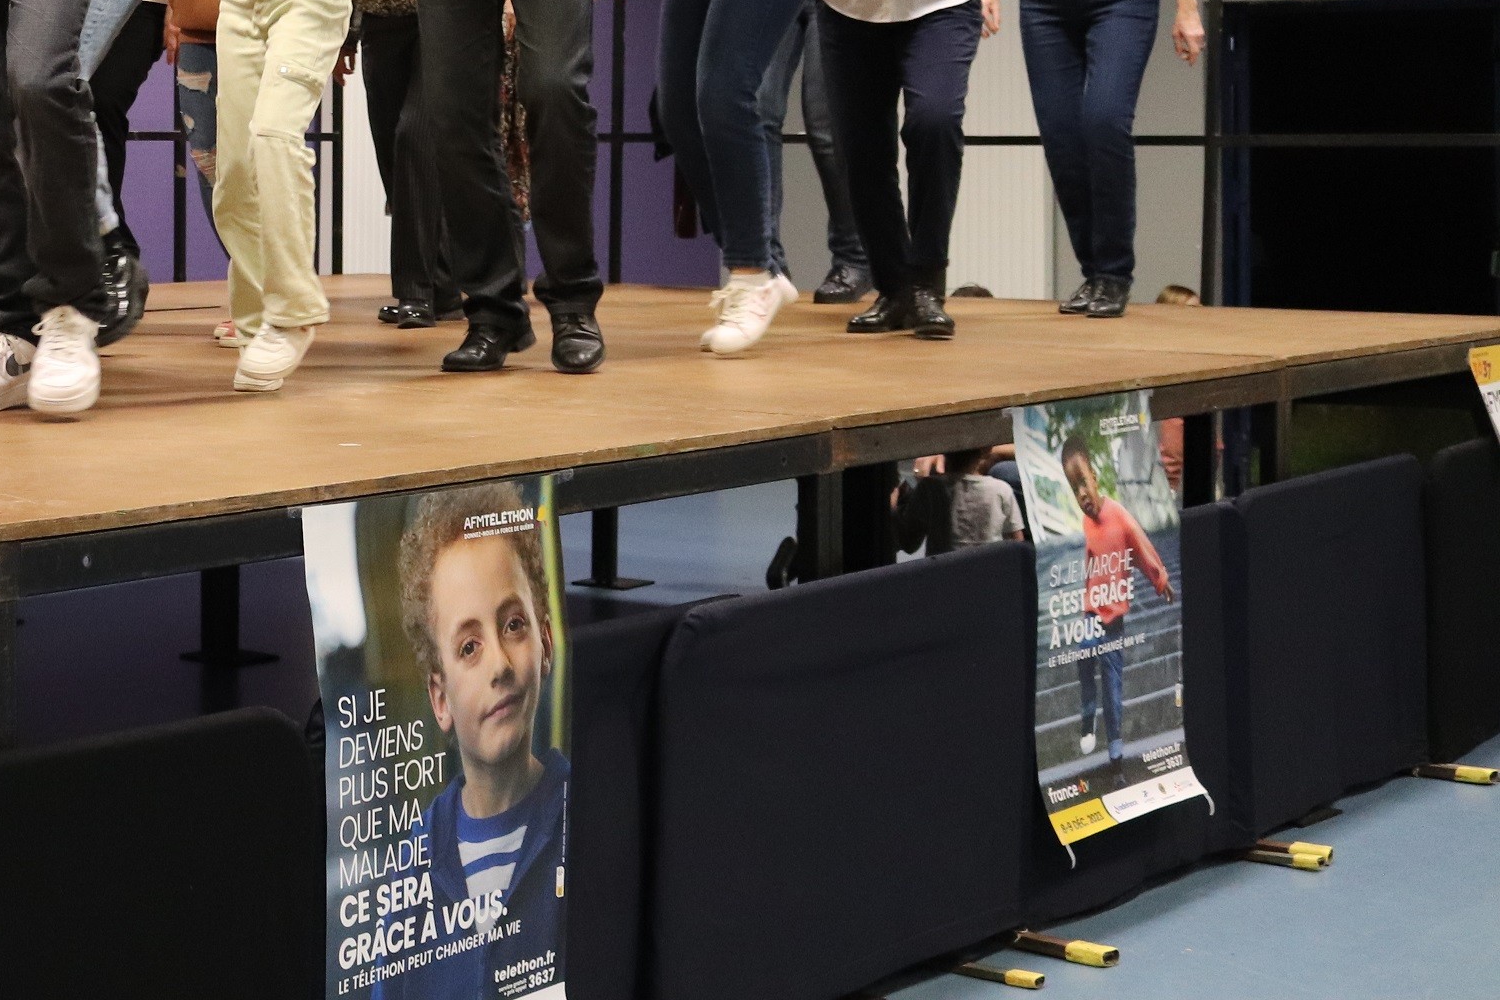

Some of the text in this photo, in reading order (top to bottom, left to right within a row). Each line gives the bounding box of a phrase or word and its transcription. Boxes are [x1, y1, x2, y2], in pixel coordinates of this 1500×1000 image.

[464, 530, 495, 540] DONNEZ-NOUS
[1050, 548, 1135, 588] SI JE MARCHE
[1049, 575, 1134, 618] C'EST GRÂCE
[1049, 632, 1145, 668] LE TÉLÉTHON A CHANGÉ MA VIE
[1050, 615, 1105, 650] À VOUS.
[338, 689, 387, 729] SI JE
[339, 720, 424, 769] DEVIENS
[1142, 742, 1180, 763] telethon.fr
[1165, 754, 1183, 769] 3637
[339, 752, 446, 809] PLUS FORT
[339, 798, 424, 850] QUE MA
[339, 834, 432, 889] MALADIE,
[339, 872, 434, 927] CE SERA
[338, 889, 508, 970] GRÂCE À VOUS.
[338, 919, 521, 995] LE TÉLÉTHON PEUT CHANGER MA VIE
[495, 950, 555, 982] telethon.fr
[528, 967, 555, 988] 3637
